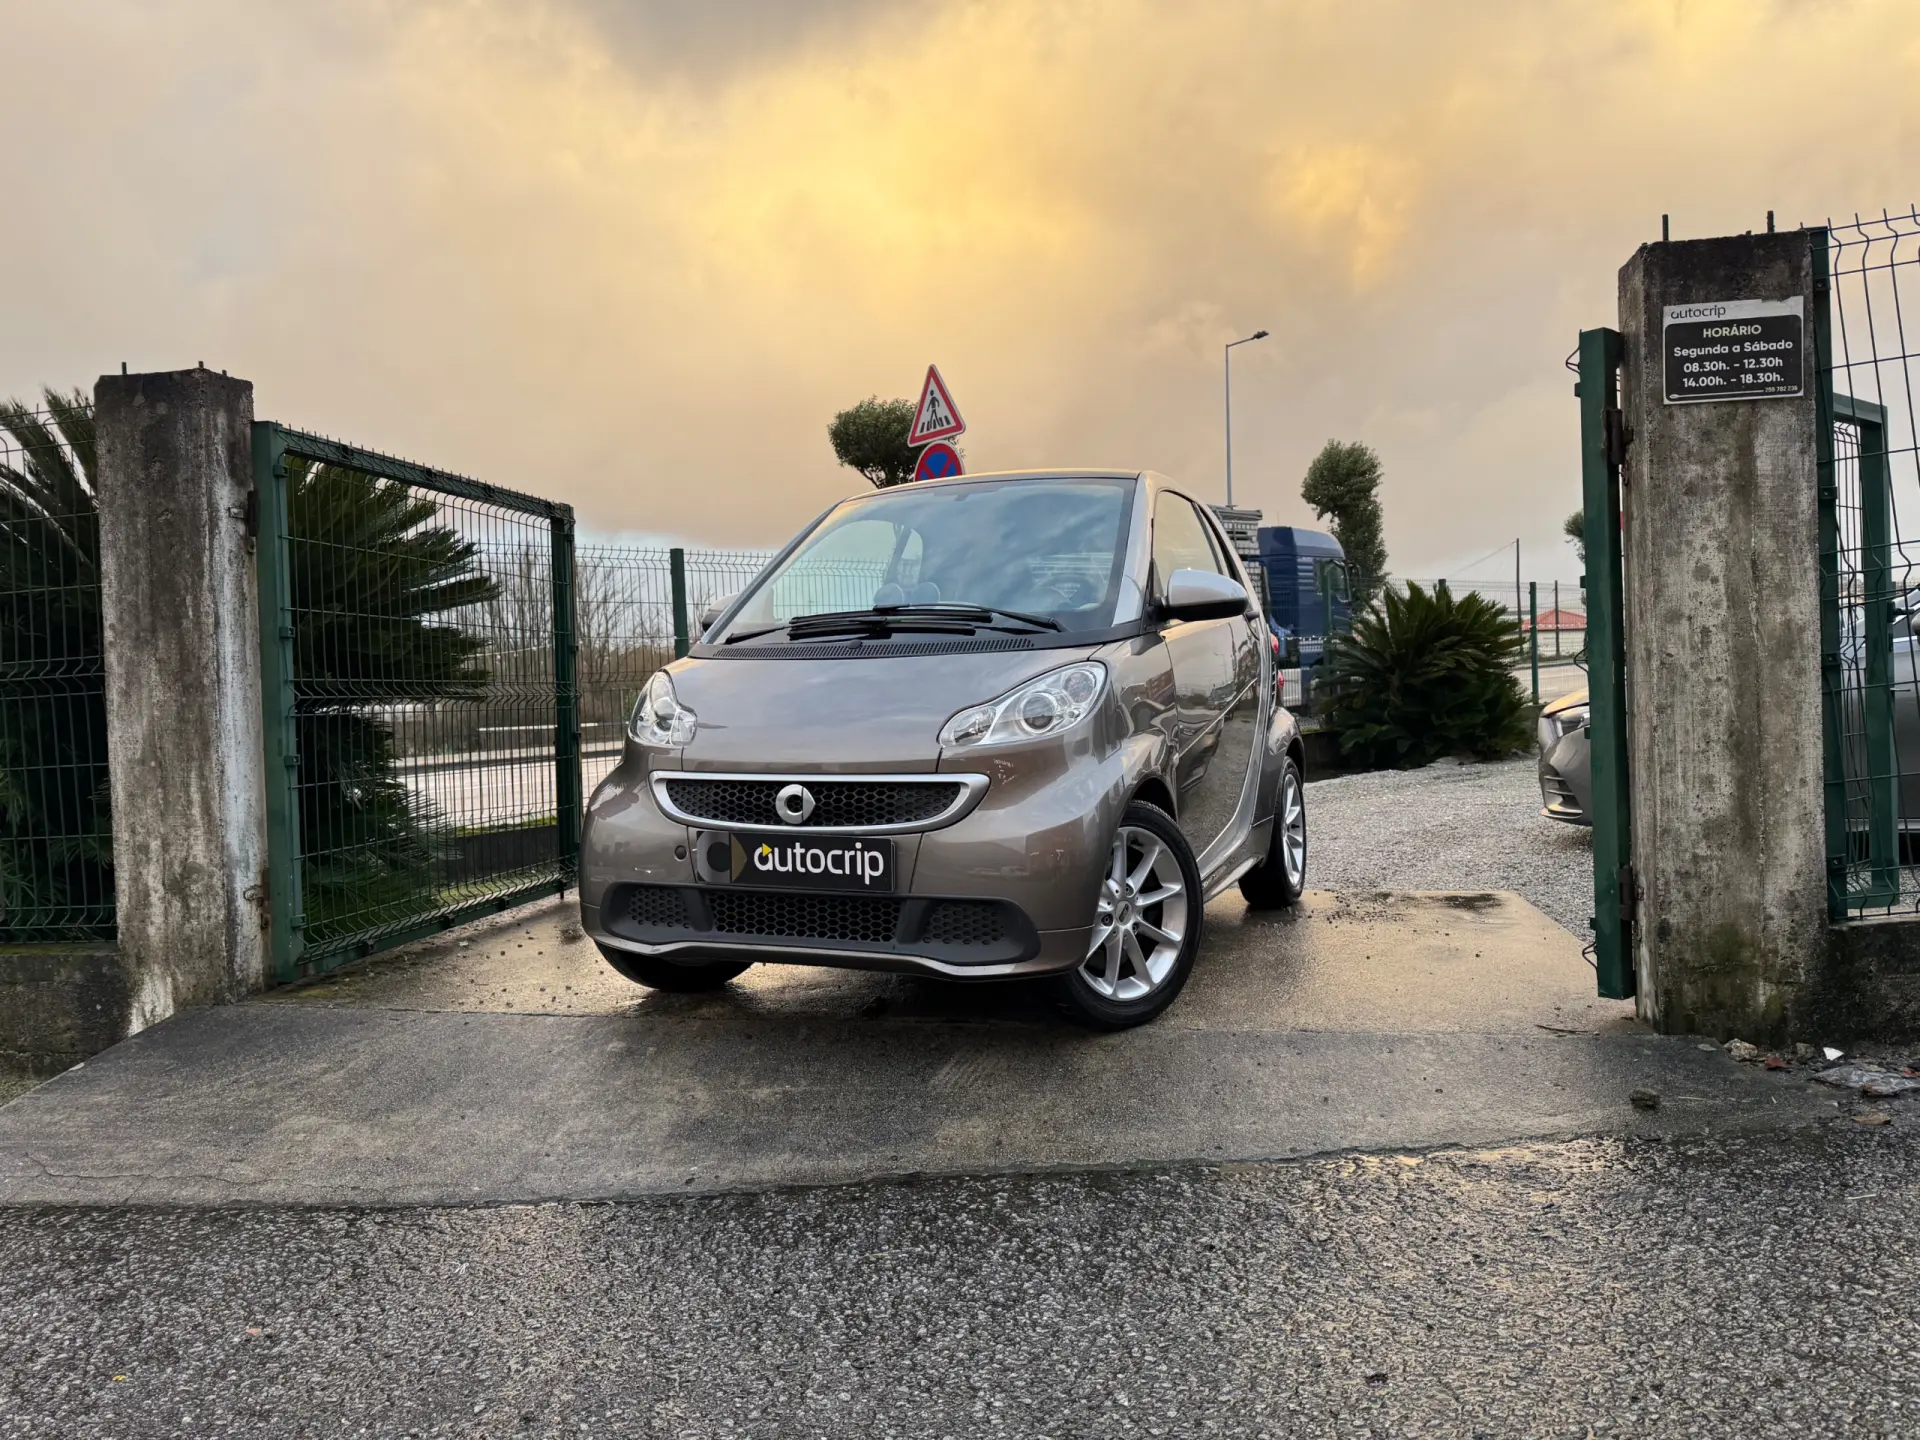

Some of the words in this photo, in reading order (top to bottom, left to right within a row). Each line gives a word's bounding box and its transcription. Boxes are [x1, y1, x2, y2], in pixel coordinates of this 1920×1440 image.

[1670, 305, 1726, 320] autocrip
[1703, 324, 1762, 338] HORÁRIO
[1673, 342, 1729, 358] Segunda
[1732, 344, 1741, 353] a
[1743, 339, 1793, 352] Sábado
[1683, 361, 1730, 373] 08.30h.
[1743, 357, 1783, 369] 12.30h
[1682, 375, 1727, 388] 14.00h.
[1740, 372, 1784, 384] 18.30h.
[753, 842, 884, 885] autocrip
